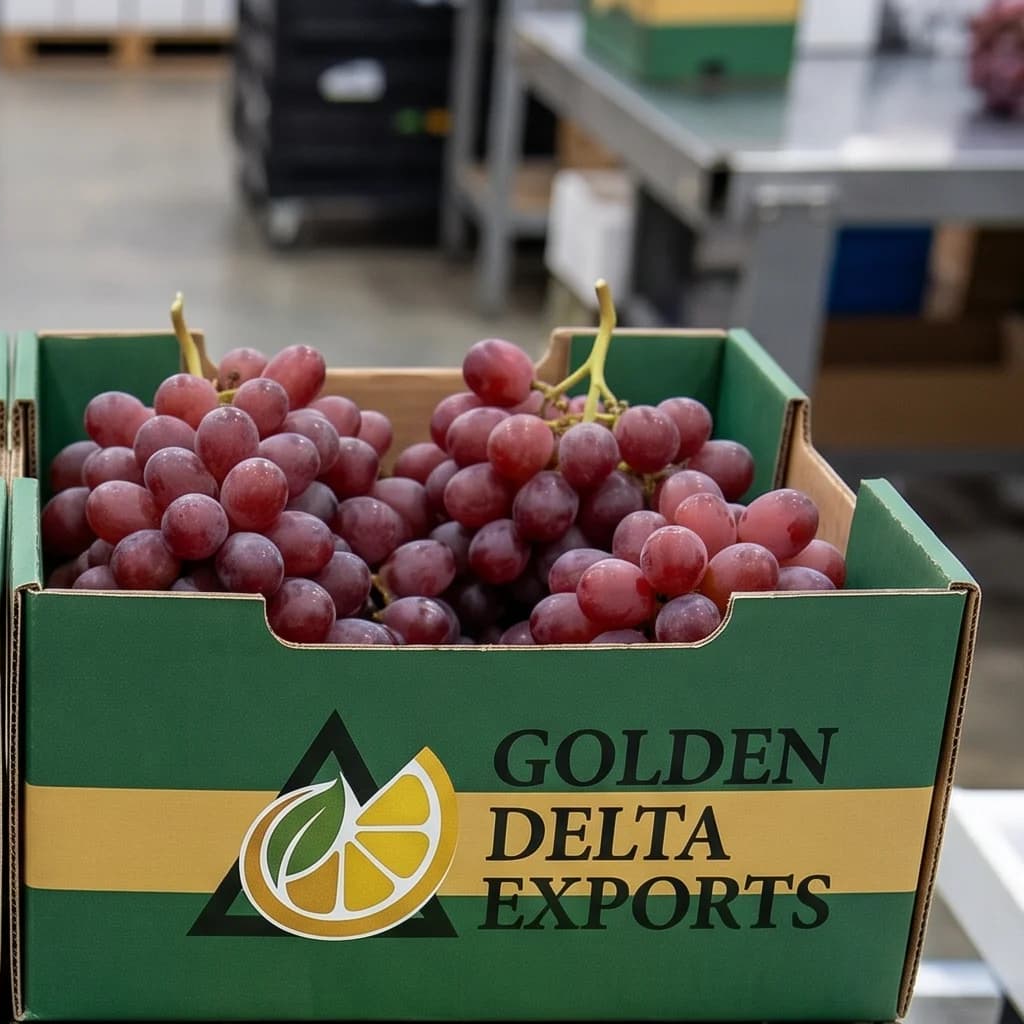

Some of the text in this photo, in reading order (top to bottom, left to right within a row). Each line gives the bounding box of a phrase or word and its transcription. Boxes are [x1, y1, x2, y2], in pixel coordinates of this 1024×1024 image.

[493, 727, 840, 788] GOLDEN
[485, 805, 730, 861] DELTA
[477, 874, 831, 931] EXPORTS
